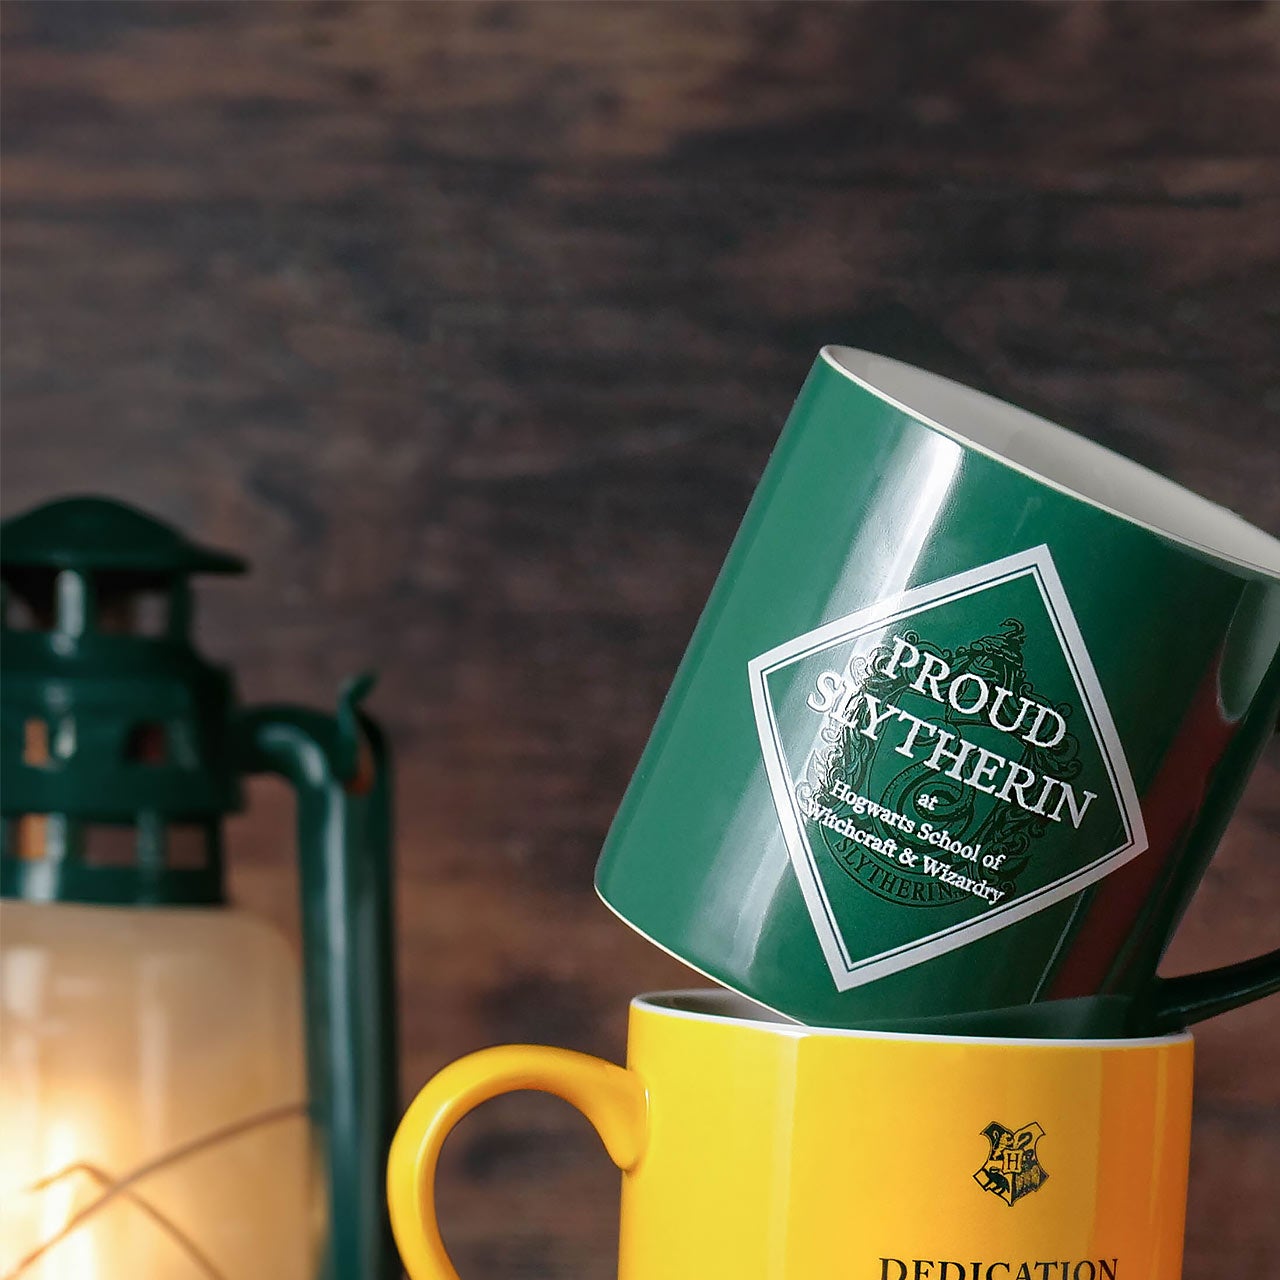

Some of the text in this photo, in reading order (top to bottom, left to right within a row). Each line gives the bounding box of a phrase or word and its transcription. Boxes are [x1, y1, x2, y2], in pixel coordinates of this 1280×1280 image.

[882, 635, 1067, 748] PROUD
[807, 671, 1098, 829] SLYTHERIN
[917, 793, 938, 811] at
[806, 800, 1005, 905] Witchcraft & Wizardry
[829, 779, 1006, 871] Hogwarts School of
